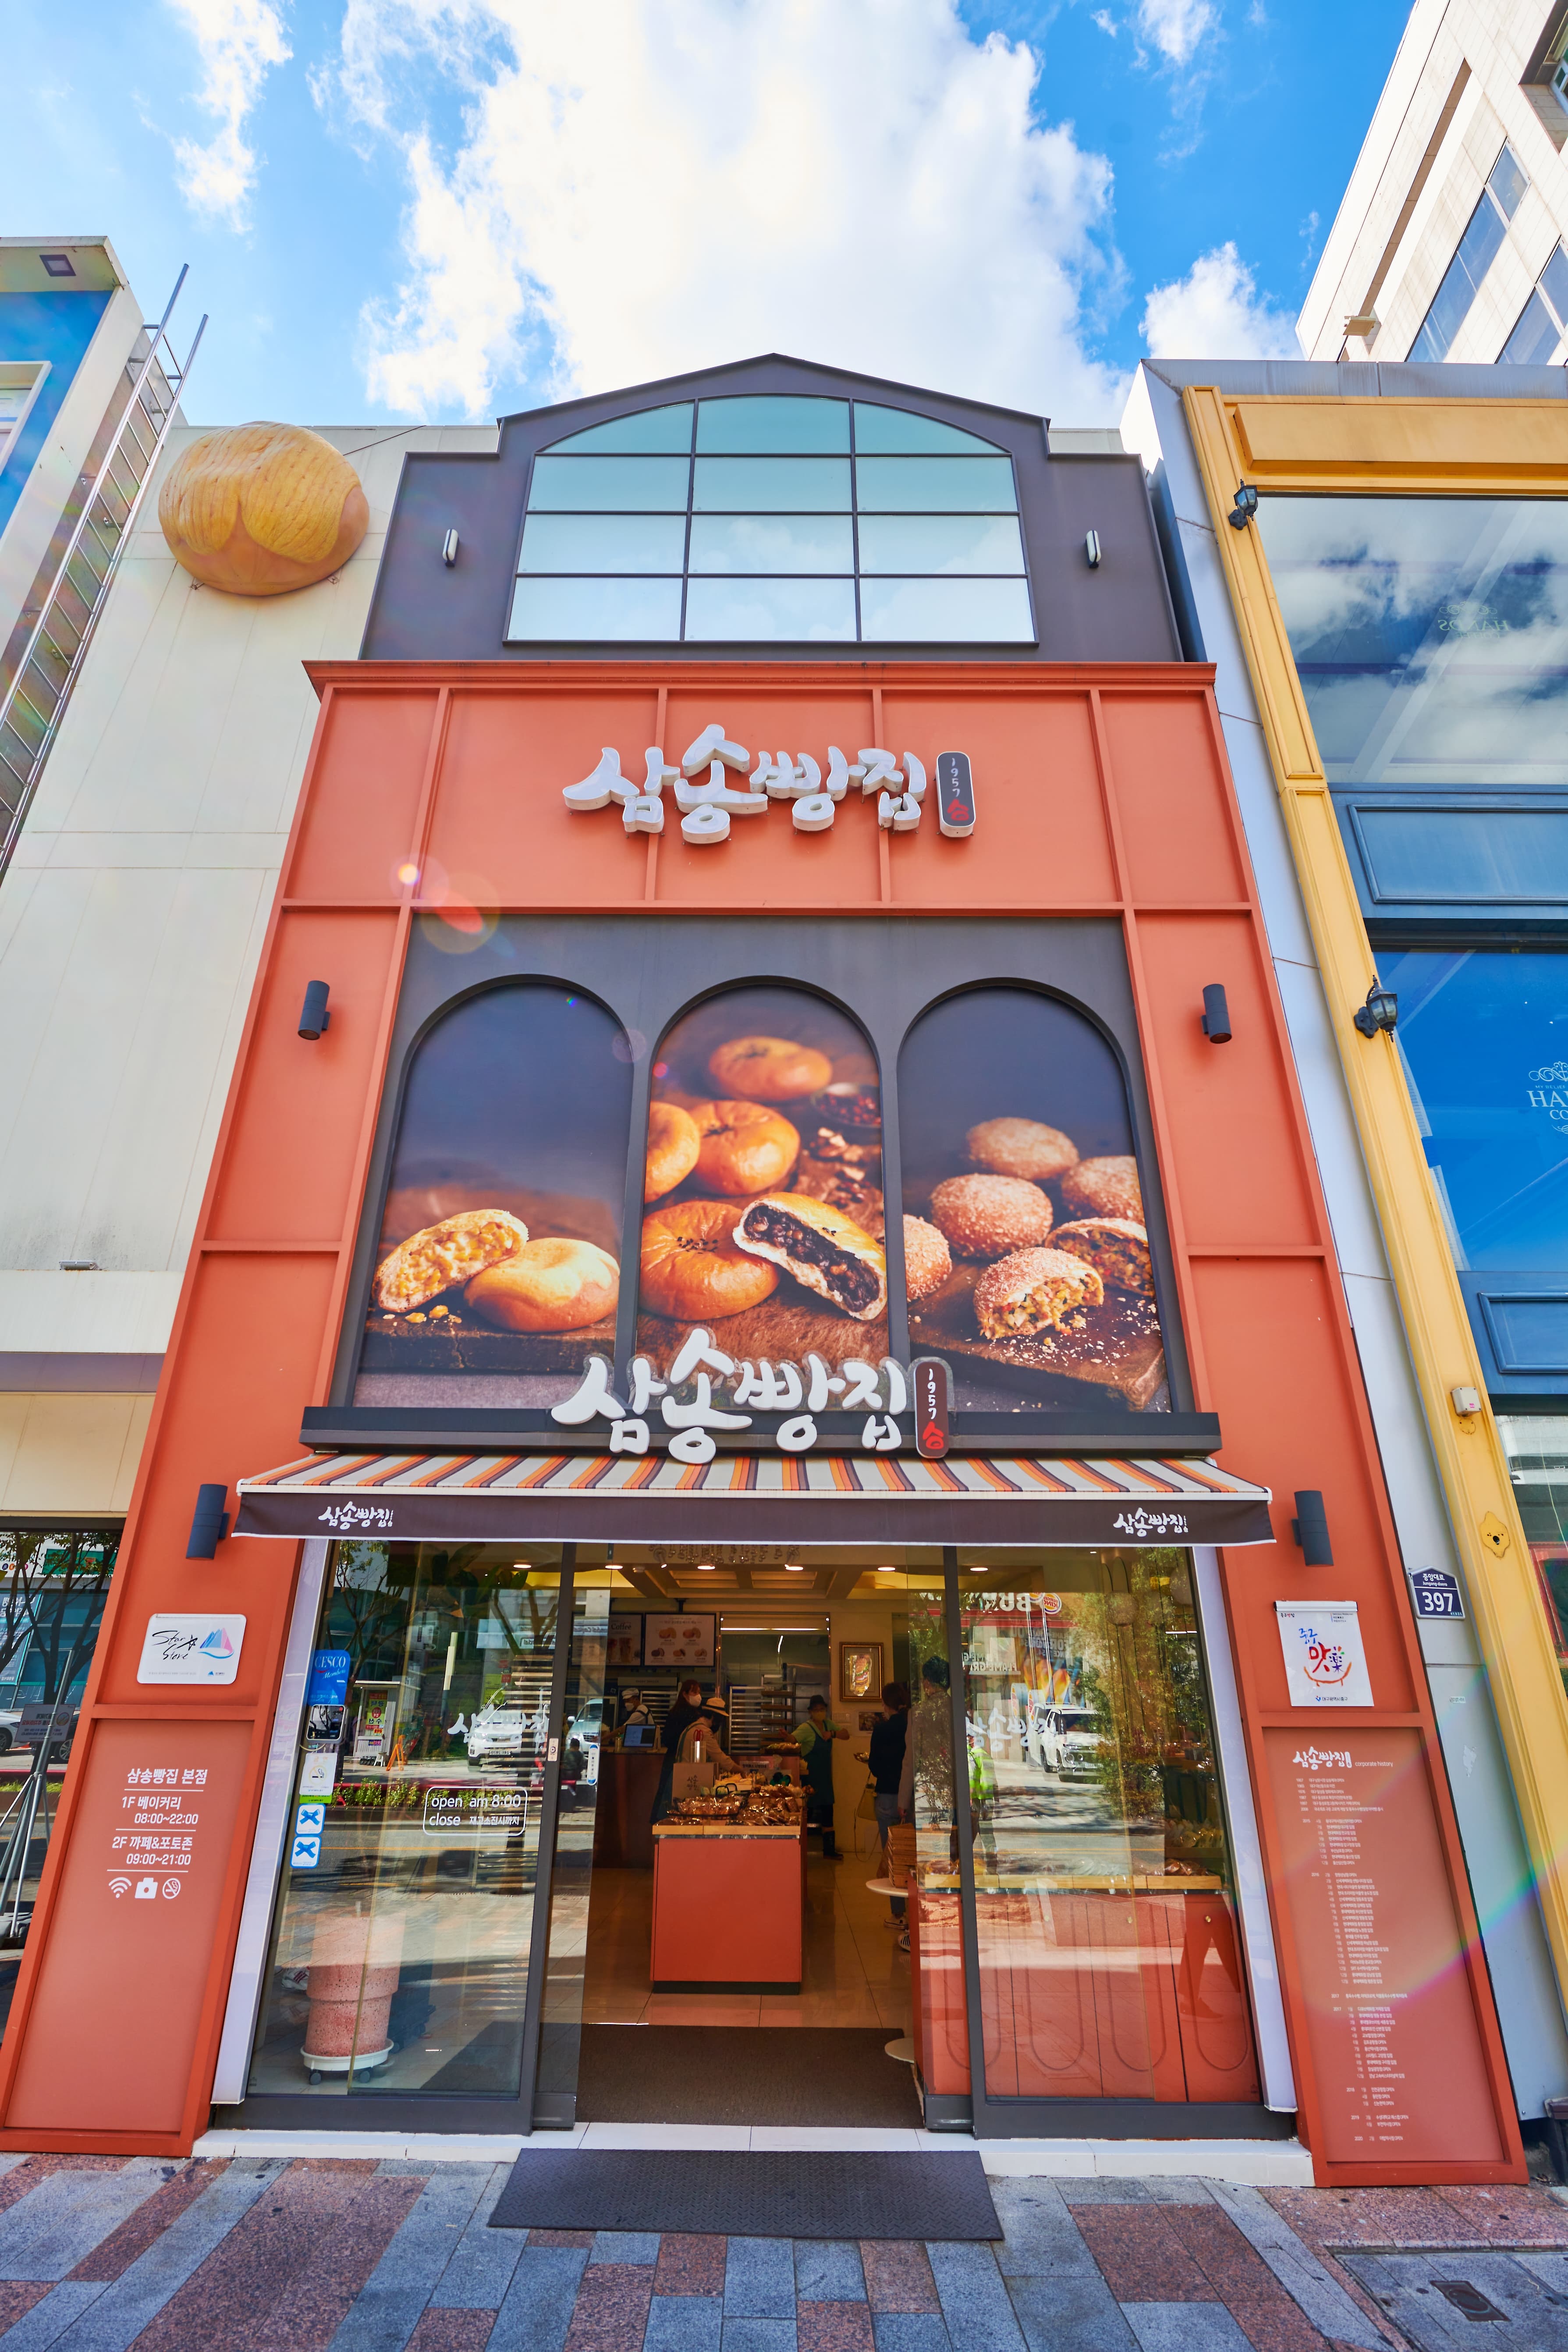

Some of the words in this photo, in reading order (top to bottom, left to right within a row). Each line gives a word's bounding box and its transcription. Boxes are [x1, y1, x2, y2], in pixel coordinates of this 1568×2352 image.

[562, 724, 926, 844] 삼송빵집
[951, 757, 960, 797] 1957
[1526, 1091, 1568, 1107] HA
[551, 1328, 907, 1464] 삼송빵집
[927, 1368, 937, 1419] 1957
[318, 1501, 390, 1530] 삼송빵집
[1113, 1507, 1183, 1537] 삼송빵집
[1422, 1592, 1453, 1612] 397
[315, 1656, 346, 1668] CESCO
[1292, 1746, 1345, 1770] 삼송빵집
[127, 1768, 179, 1784] 삼송빵집
[182, 1769, 208, 1784] 본점
[122, 1796, 136, 1808] 1F
[137, 1796, 181, 1810] 베이커리
[431, 1797, 462, 1810] open
[469, 1798, 488, 1808] am
[492, 1794, 521, 1808] 8:00
[134, 1813, 199, 1824] 08:00~22:00
[429, 1812, 461, 1826] close
[470, 1816, 520, 1826] 재고소진시까지
[112, 1836, 128, 1848] 2F
[129, 1836, 193, 1851] 까페&포토존
[126, 1853, 191, 1865] 09:00~21:00
